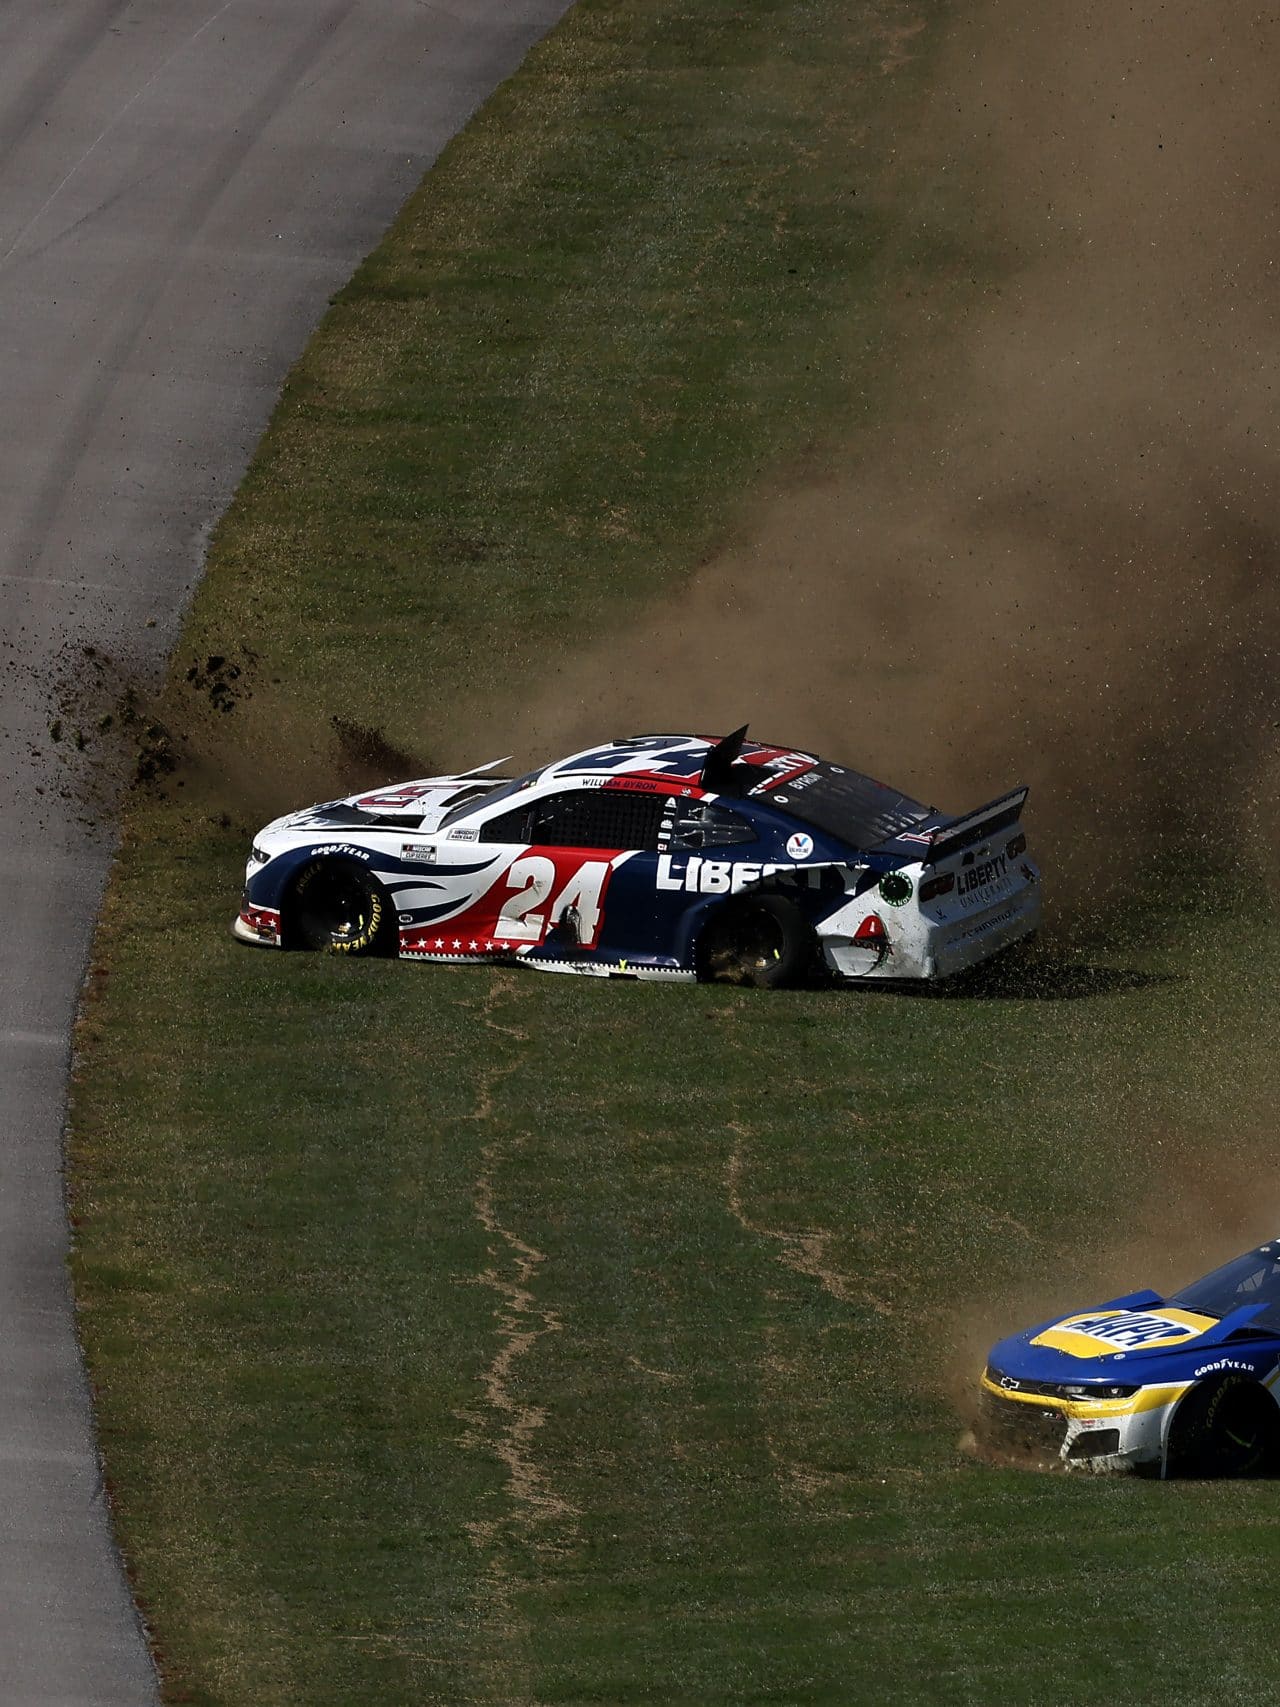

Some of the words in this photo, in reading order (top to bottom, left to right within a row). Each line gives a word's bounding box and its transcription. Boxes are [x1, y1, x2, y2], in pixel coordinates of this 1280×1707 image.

[582, 778, 621, 787] WILLIAM
[624, 781, 657, 790] BYRON
[311, 844, 370, 861] GOODYEAR
[956, 853, 1009, 895] LIBERTY
[494, 856, 609, 945] 24
[1194, 1358, 1256, 1377] GOODYEAR
